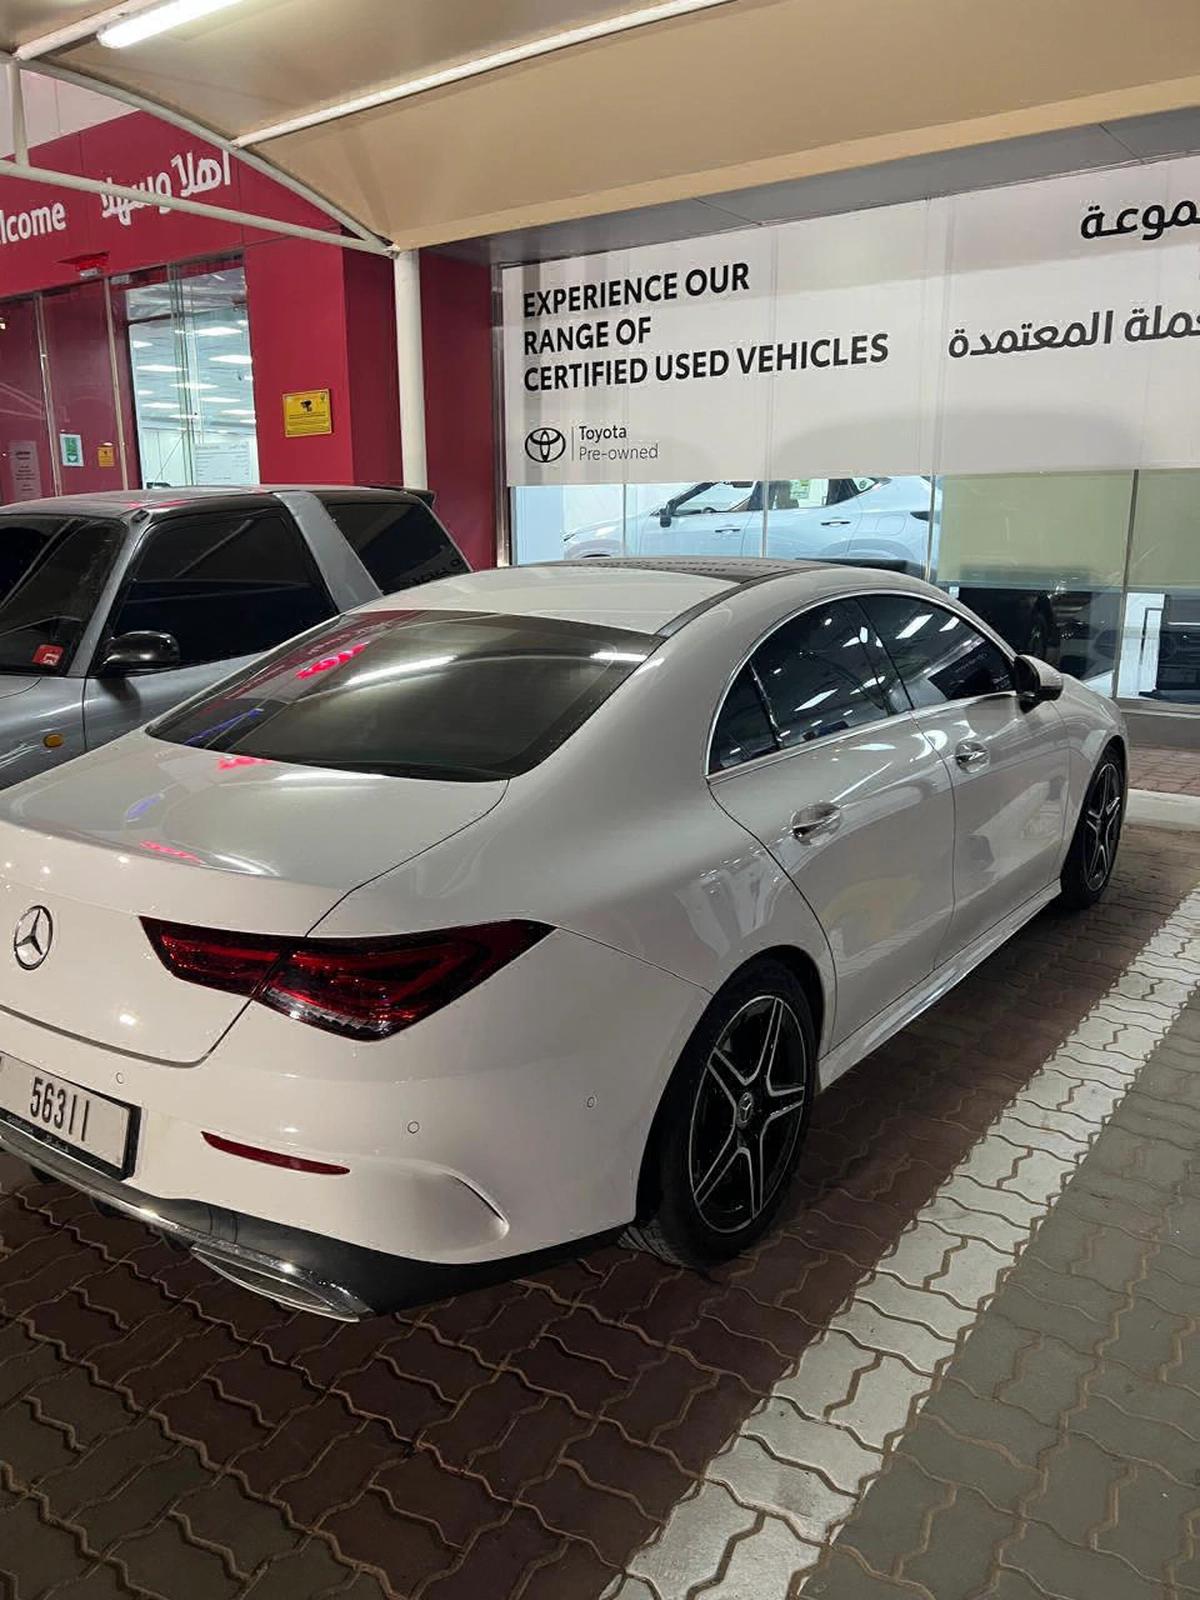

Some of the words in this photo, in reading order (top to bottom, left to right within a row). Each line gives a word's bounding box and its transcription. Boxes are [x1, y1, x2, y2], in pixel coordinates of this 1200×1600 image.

[0, 202, 67, 245] lcome
[1080, 199, 1200, 241] موعة
[523, 272, 678, 318] EXPERIENCE
[685, 262, 750, 294] OUR
[523, 321, 609, 355] RANGE
[615, 316, 652, 345] OF
[948, 310, 1114, 358] المعتمدة
[1124, 304, 1200, 342] ملة
[523, 357, 648, 392] CERTIFIED
[655, 350, 730, 381] USED
[736, 333, 889, 375] VEHICLES
[578, 425, 627, 444] Toyota
[579, 443, 659, 461] Pre-owned
[29, 1076, 90, 1142] 56311
